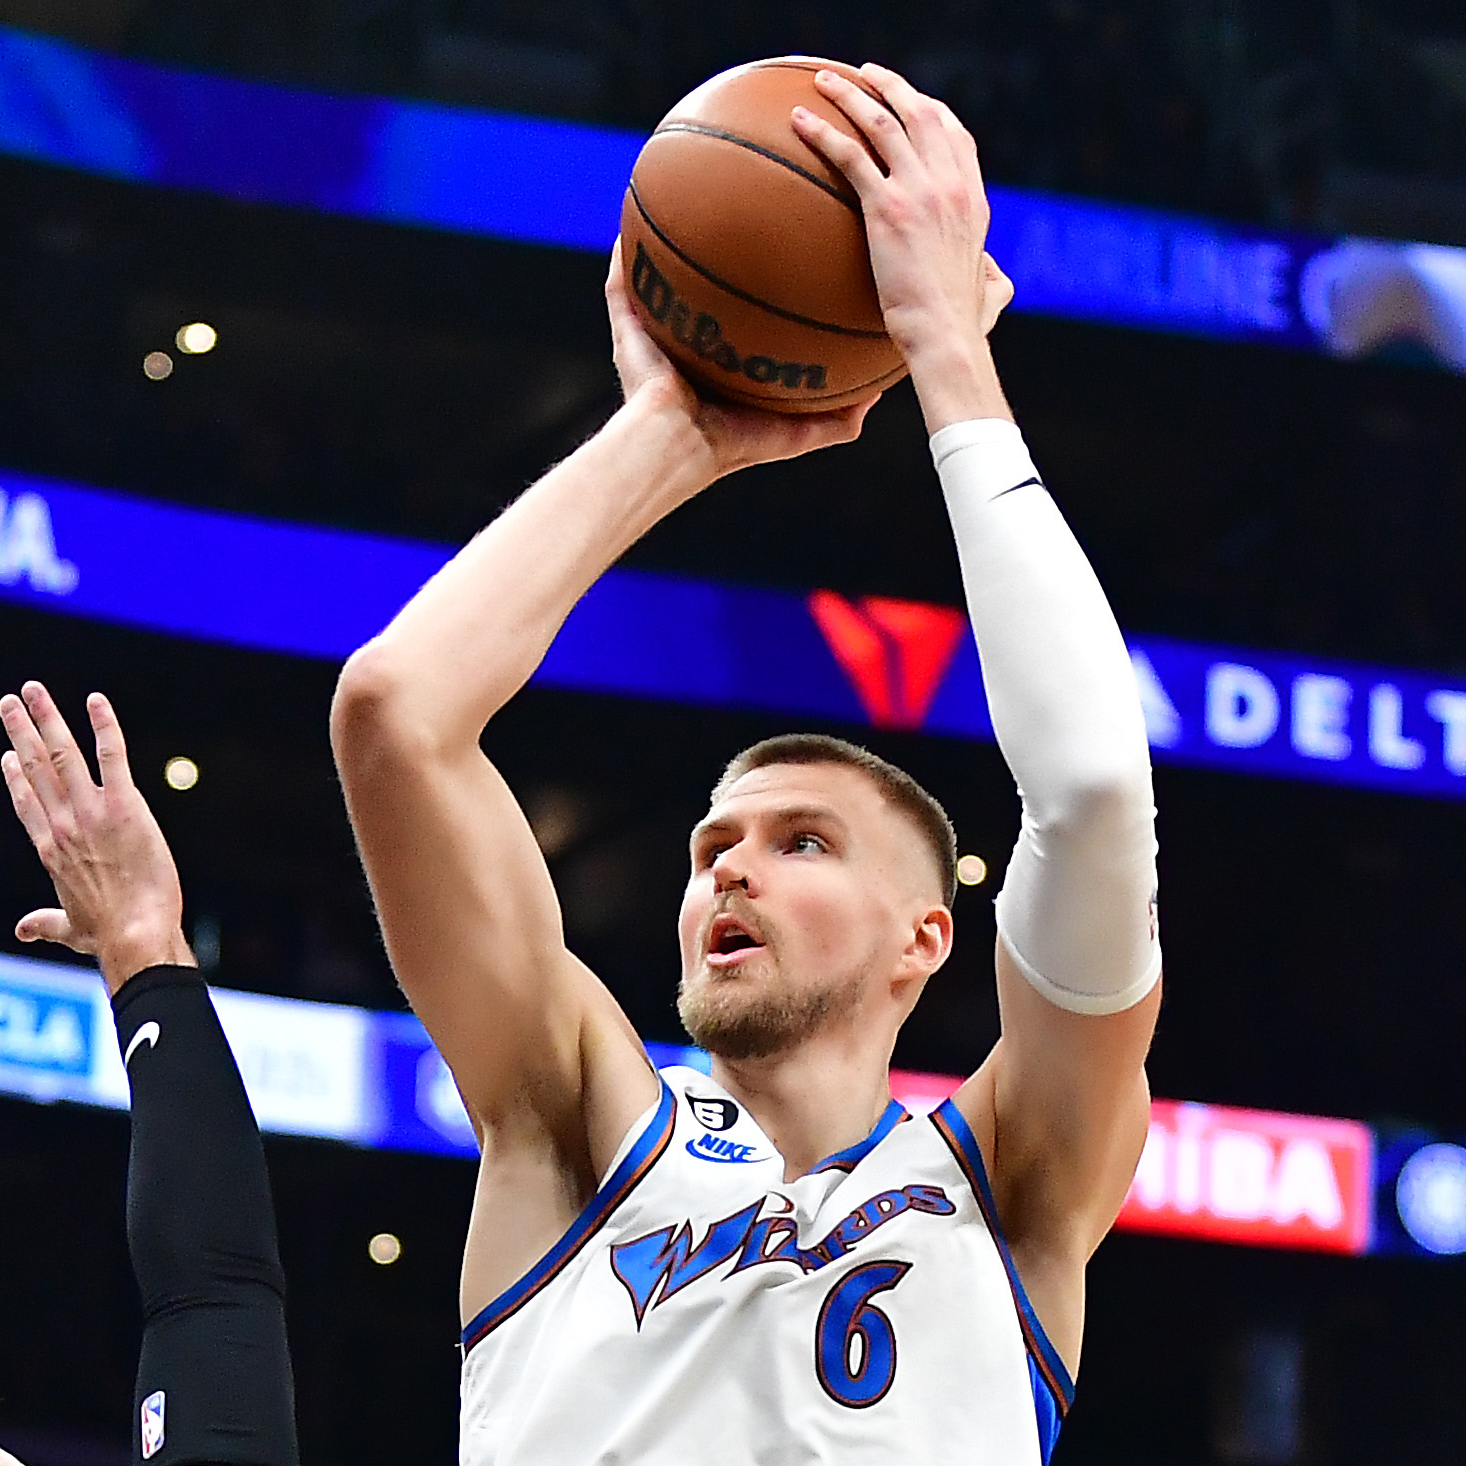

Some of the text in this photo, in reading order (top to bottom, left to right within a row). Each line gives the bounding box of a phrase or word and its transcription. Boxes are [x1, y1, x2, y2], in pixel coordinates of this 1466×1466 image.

[633, 241, 828, 389] Wilson
[697, 1133, 757, 1162] NIKE
[814, 1259, 914, 1410] 6
